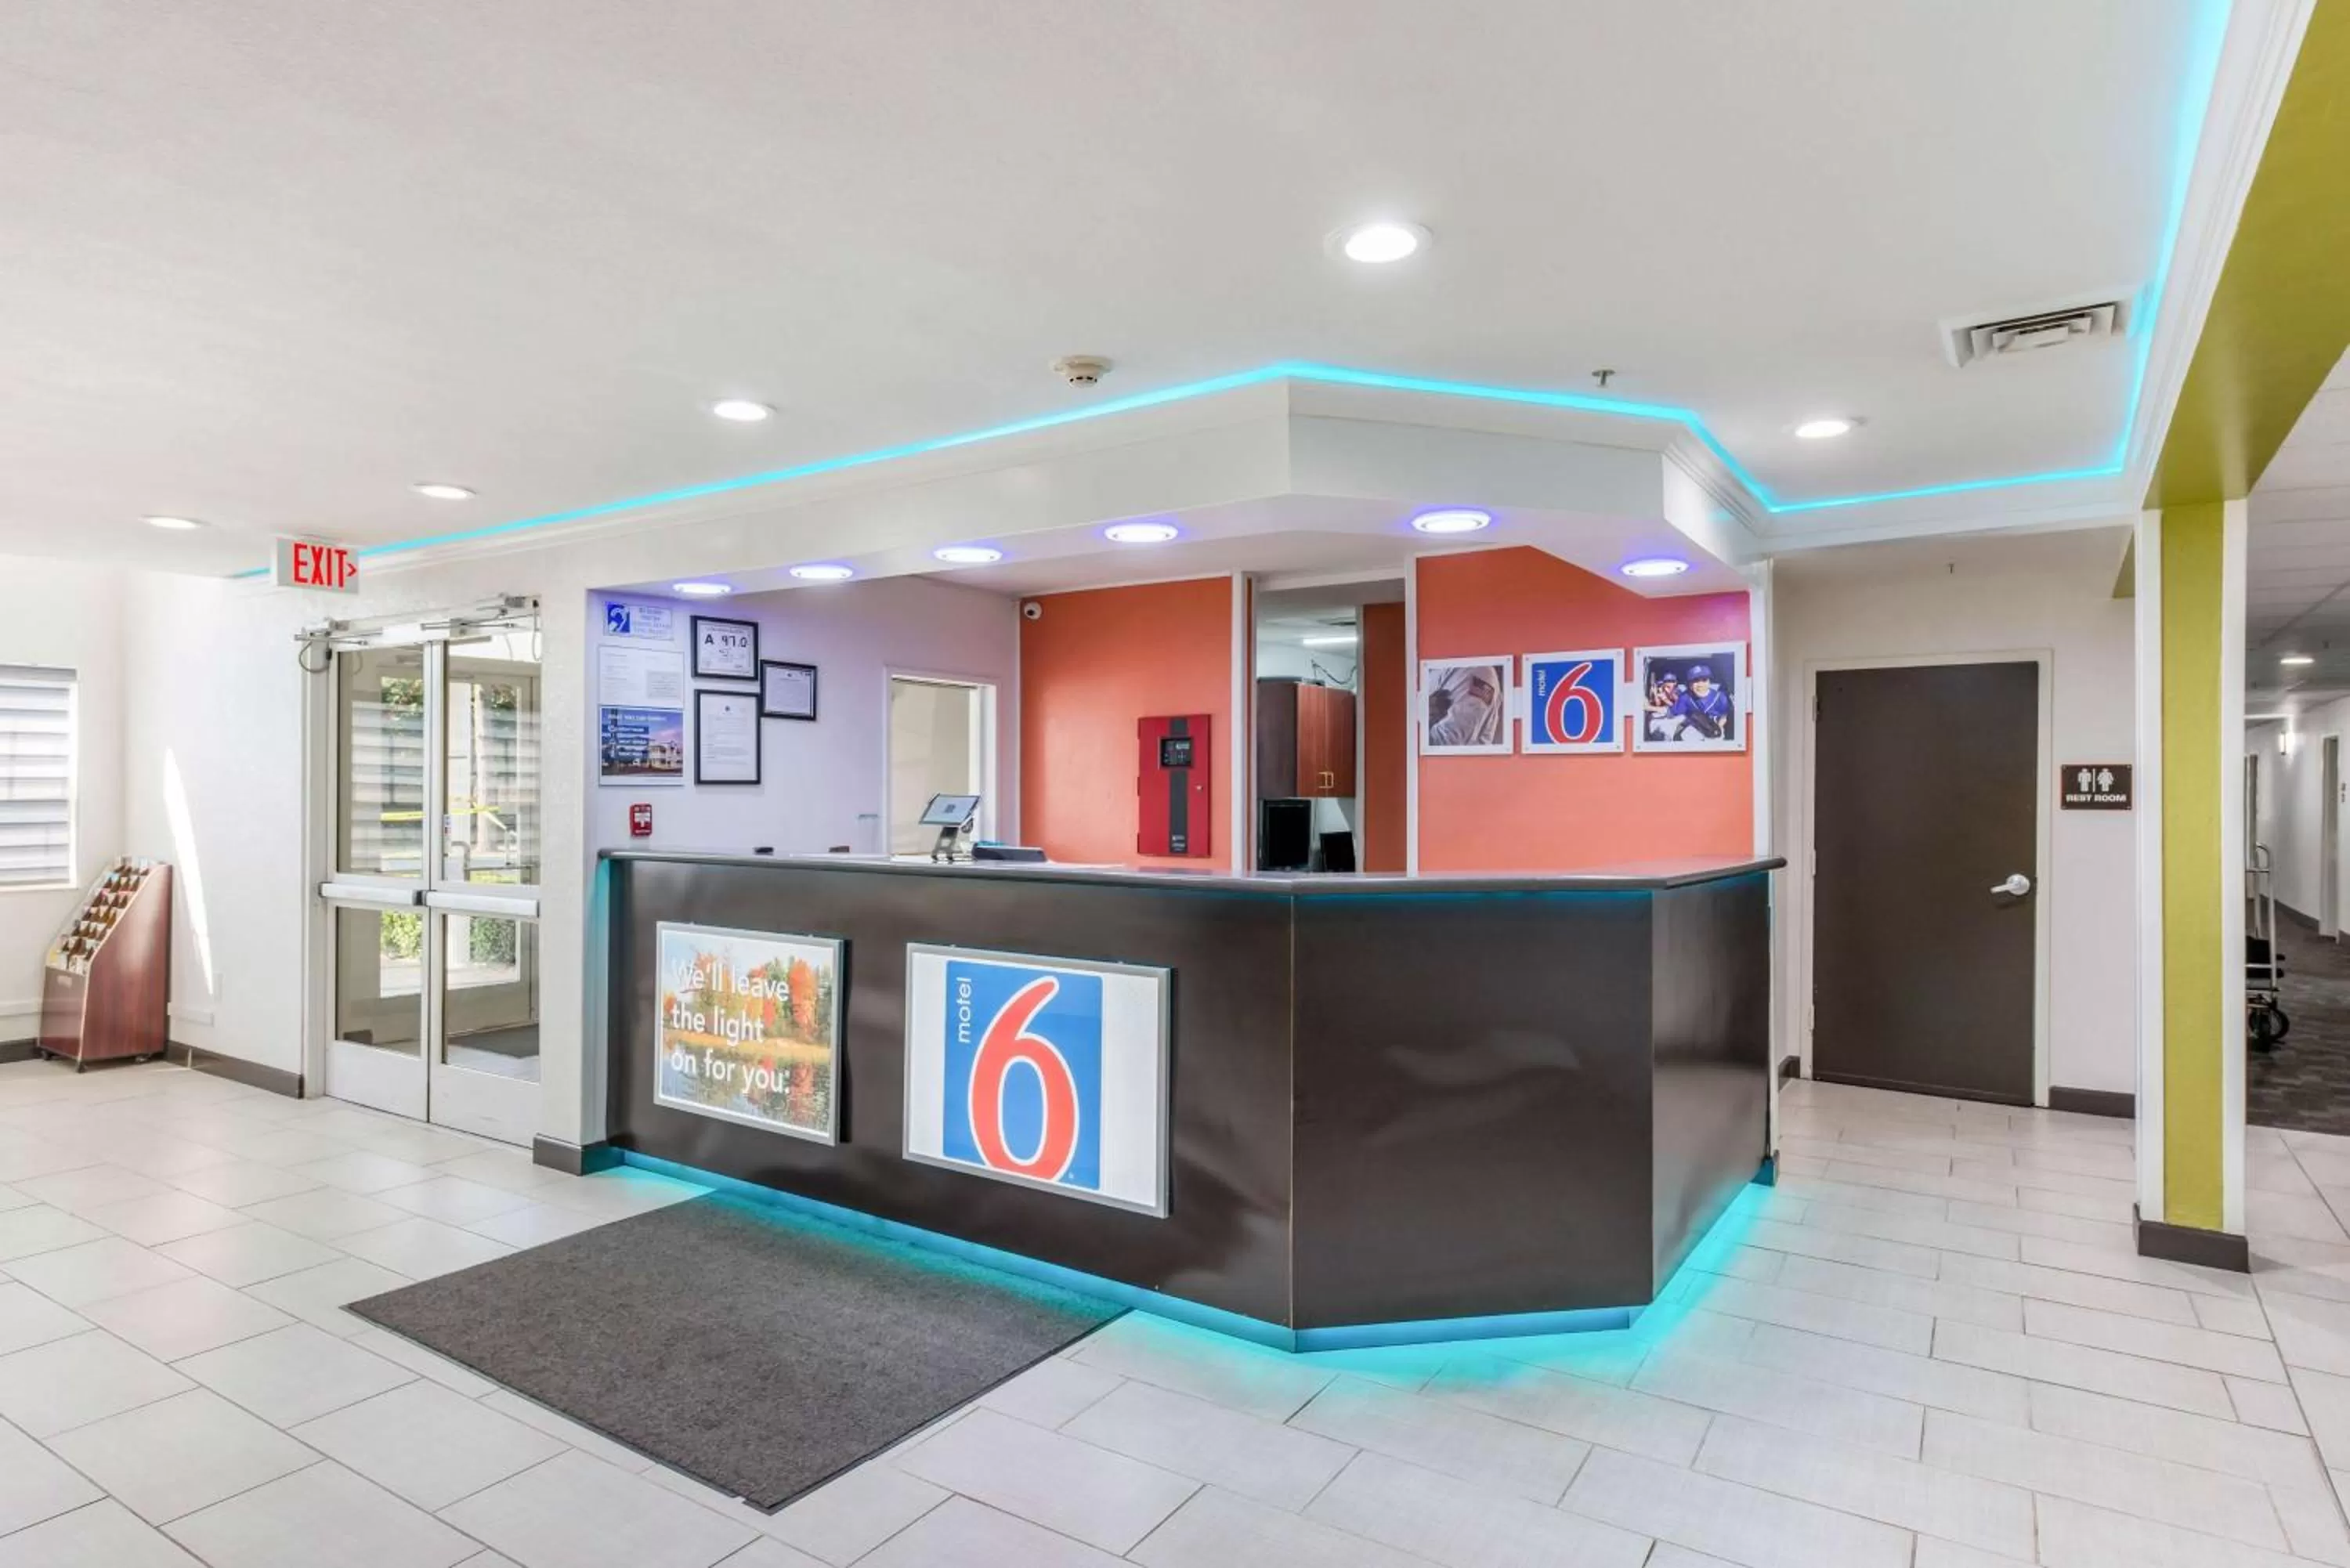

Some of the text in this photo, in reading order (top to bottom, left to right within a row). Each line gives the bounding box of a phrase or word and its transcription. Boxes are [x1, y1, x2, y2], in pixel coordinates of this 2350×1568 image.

[294, 543, 347, 588] EXIT
[704, 634, 714, 645] A
[1545, 662, 1603, 744] 6
[2066, 793, 2127, 802] REST ROOM
[671, 957, 790, 1002] We'll leave
[671, 1003, 765, 1047] the light
[956, 977, 972, 1044] motel
[671, 1050, 696, 1075] on
[703, 1048, 736, 1082] for
[967, 975, 1080, 1183] 6
